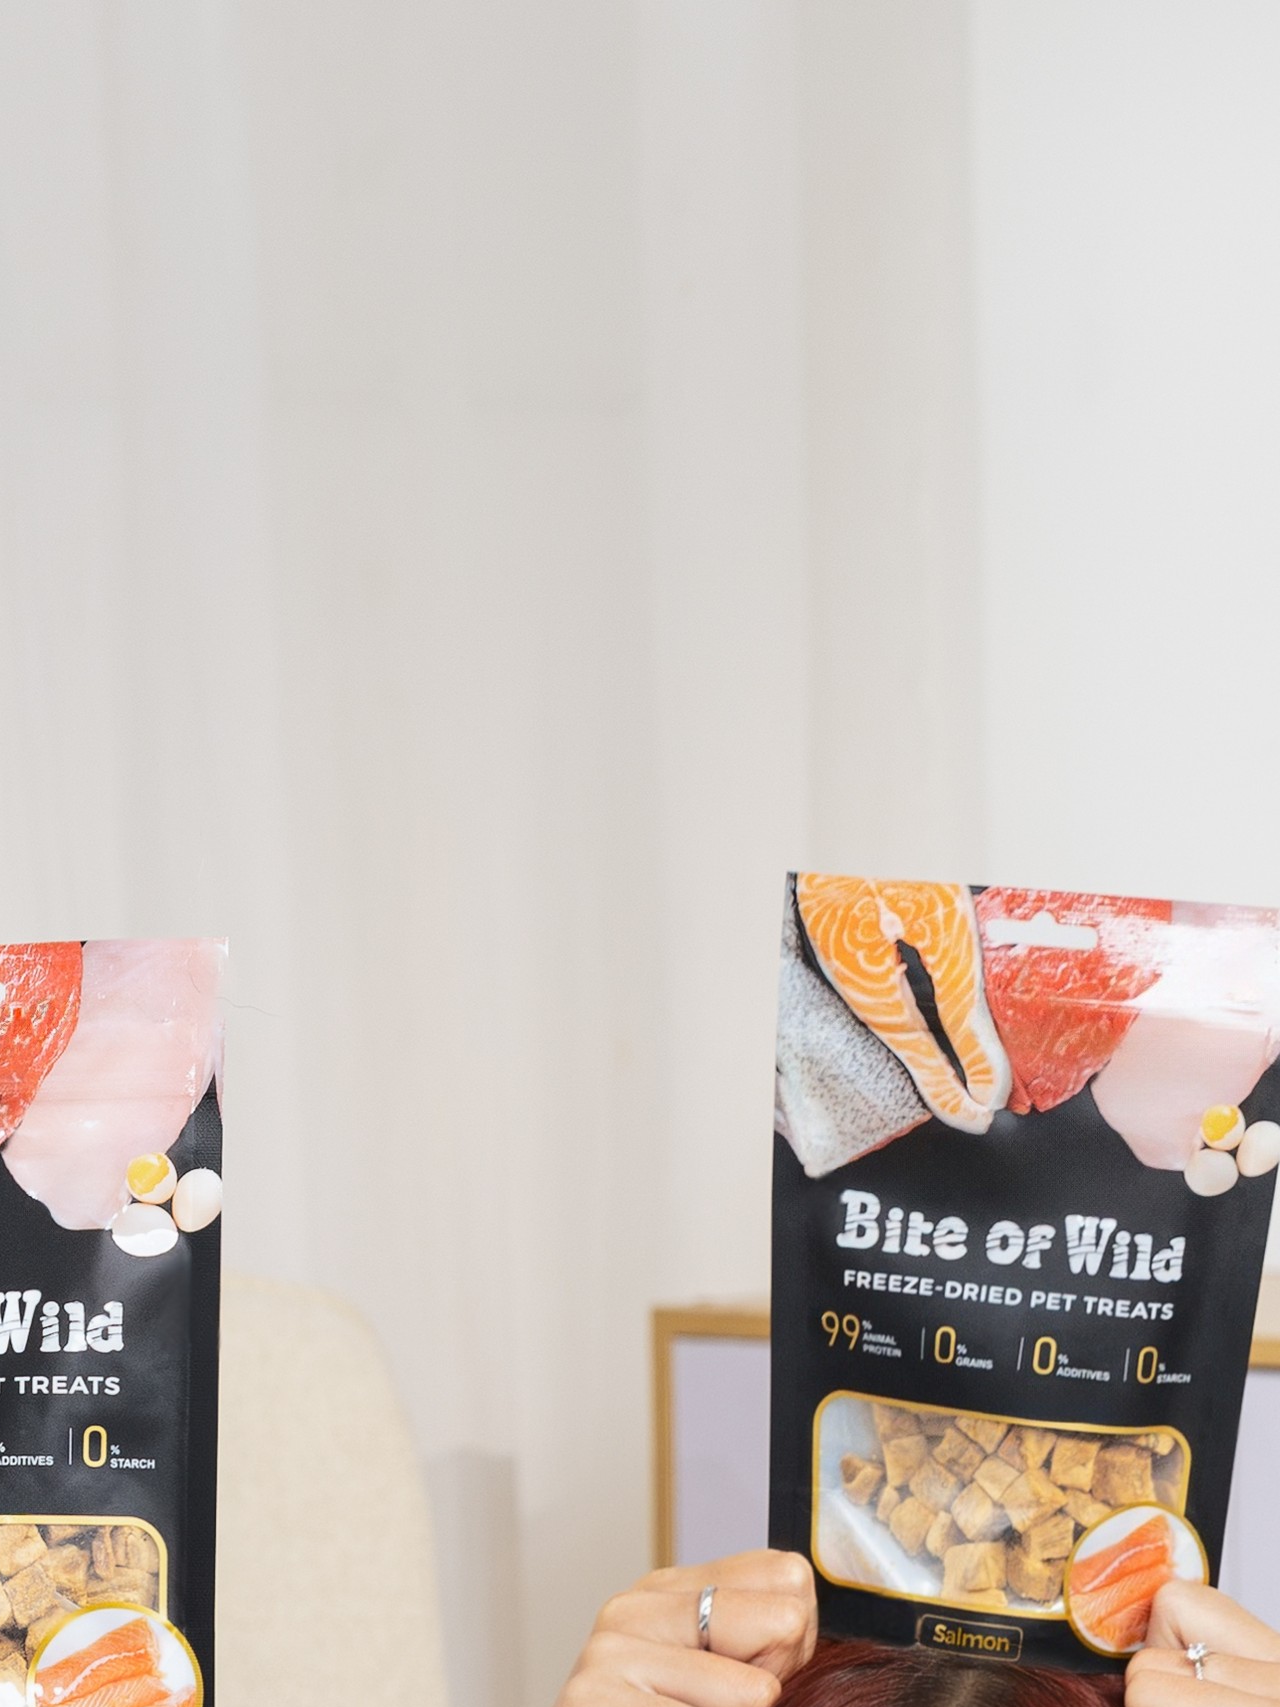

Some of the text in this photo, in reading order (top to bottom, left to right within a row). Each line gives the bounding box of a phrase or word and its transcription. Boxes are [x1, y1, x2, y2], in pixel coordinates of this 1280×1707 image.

[835, 1189, 1186, 1283] Bite of Wild
[844, 1269, 1174, 1320] FREEZE-DRIED PET TREATS
[862, 1333, 896, 1345] ANIMAL
[863, 1344, 902, 1358] PROTEIN
[955, 1357, 993, 1369] GRAINS
[1056, 1367, 1110, 1382] ADDITIVES
[15, 1375, 120, 1396] TREATS
[110, 1458, 155, 1469] STARCH
[933, 1623, 1010, 1652] Salmon
